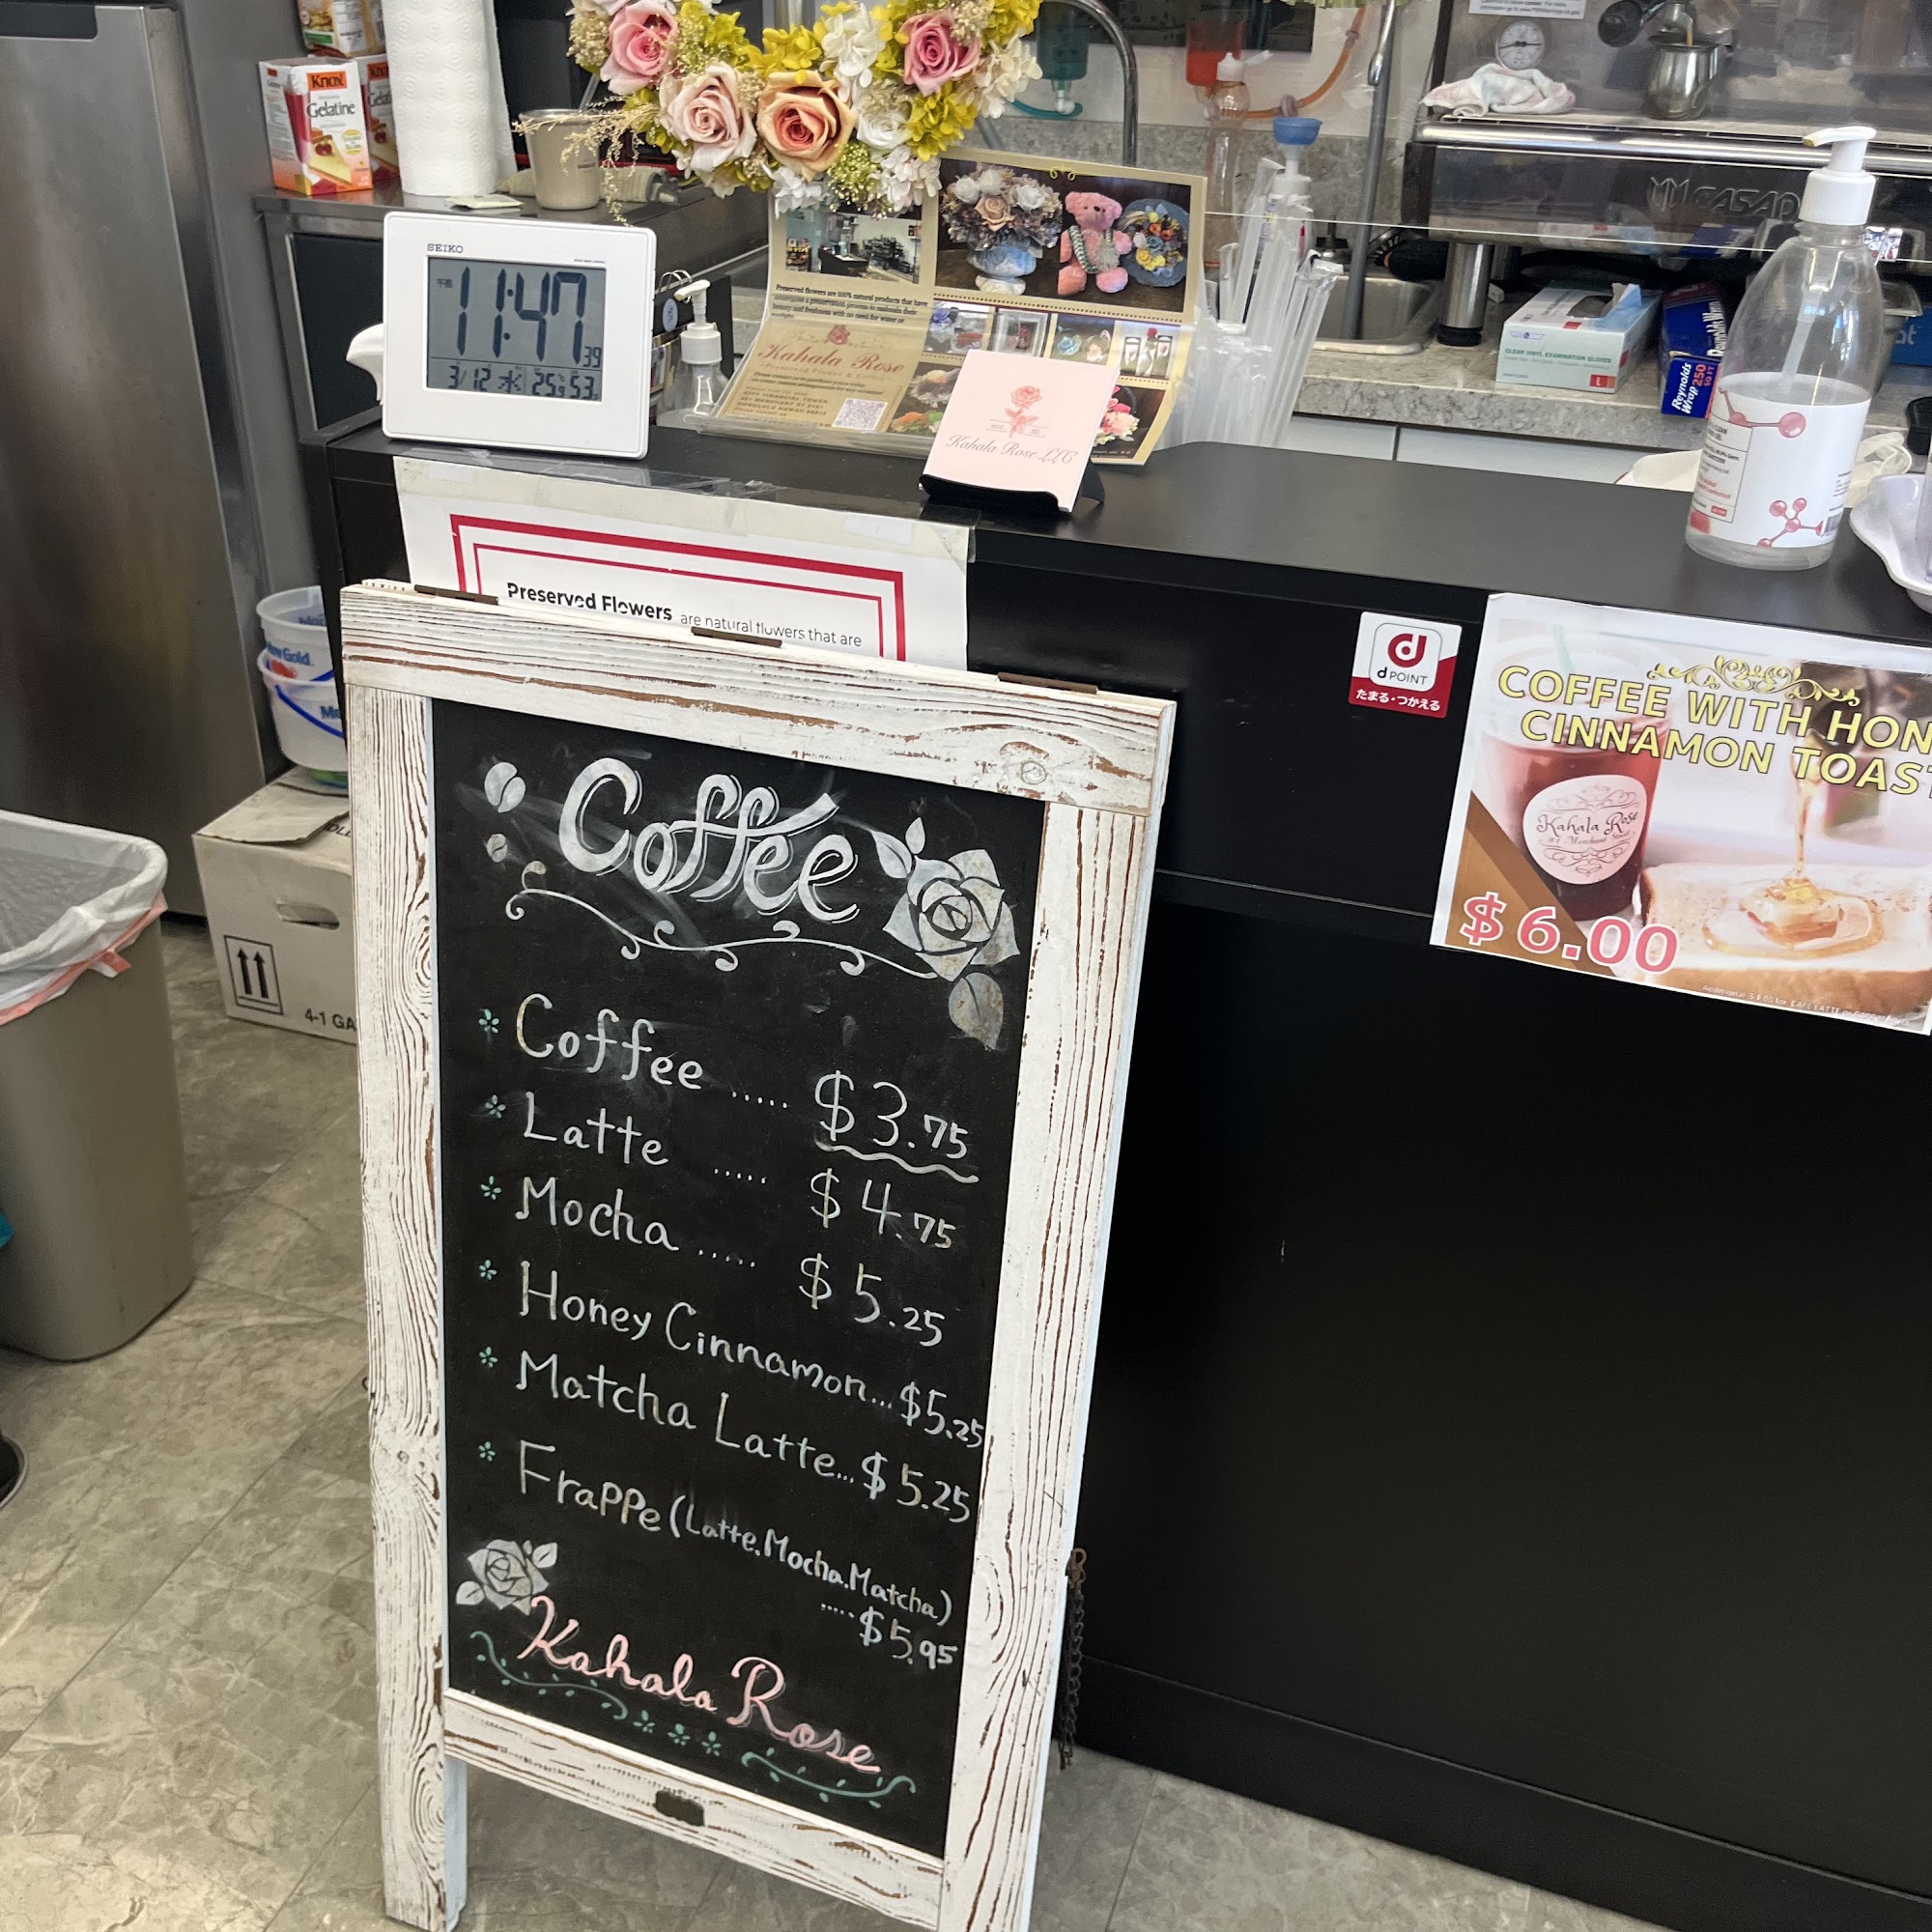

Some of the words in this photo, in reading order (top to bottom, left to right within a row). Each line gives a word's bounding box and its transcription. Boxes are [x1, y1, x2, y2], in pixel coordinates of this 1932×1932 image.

[311, 74, 343, 88] Knox
[306, 100, 355, 118] Gelatine
[1693, 185, 1801, 222] CASAD
[427, 243, 464, 254] SEIKO
[457, 266, 587, 365] 11:47
[757, 344, 842, 367] Kahala
[851, 353, 905, 373] Rose
[1691, 363, 1707, 387] 250
[1671, 362, 1692, 411] Reynolds
[1681, 385, 1698, 414] Wrap
[945, 435, 997, 454] Kahala
[1001, 442, 1037, 460] Rose
[506, 582, 597, 611] Preserved
[602, 595, 673, 621] Flowers
[680, 612, 701, 627] are
[705, 614, 753, 634] natural
[756, 621, 806, 640] flowers
[810, 628, 838, 645] that
[840, 634, 863, 647] are
[1389, 671, 1428, 685] POINT
[1355, 689, 1440, 712] たまる・つかえる
[1498, 665, 1671, 719] COFFEE
[1688, 690, 1812, 738] WITH
[1827, 709, 1932, 754] HON
[1520, 710, 1776, 774] CINNAMON
[1791, 746, 1932, 800] TOAS
[558, 757, 859, 923] Coffee
[1537, 813, 1600, 838] Kahala
[1604, 811, 1639, 836] Rose
[1702, 984, 1746, 998] Additional
[1814, 1004, 1841, 1014] LATTE
[304, 1009, 327, 1025] 4-1
[331, 1013, 356, 1032] GA
[516, 993, 703, 1090] Coffee
[524, 1092, 668, 1165] Latte
[515, 1176, 679, 1252] Mocha
[520, 1260, 653, 1341] Honey
[515, 1350, 696, 1430] Matcha
[517, 1595, 717, 1713] Kahala
[725, 1657, 882, 1774] Rose
